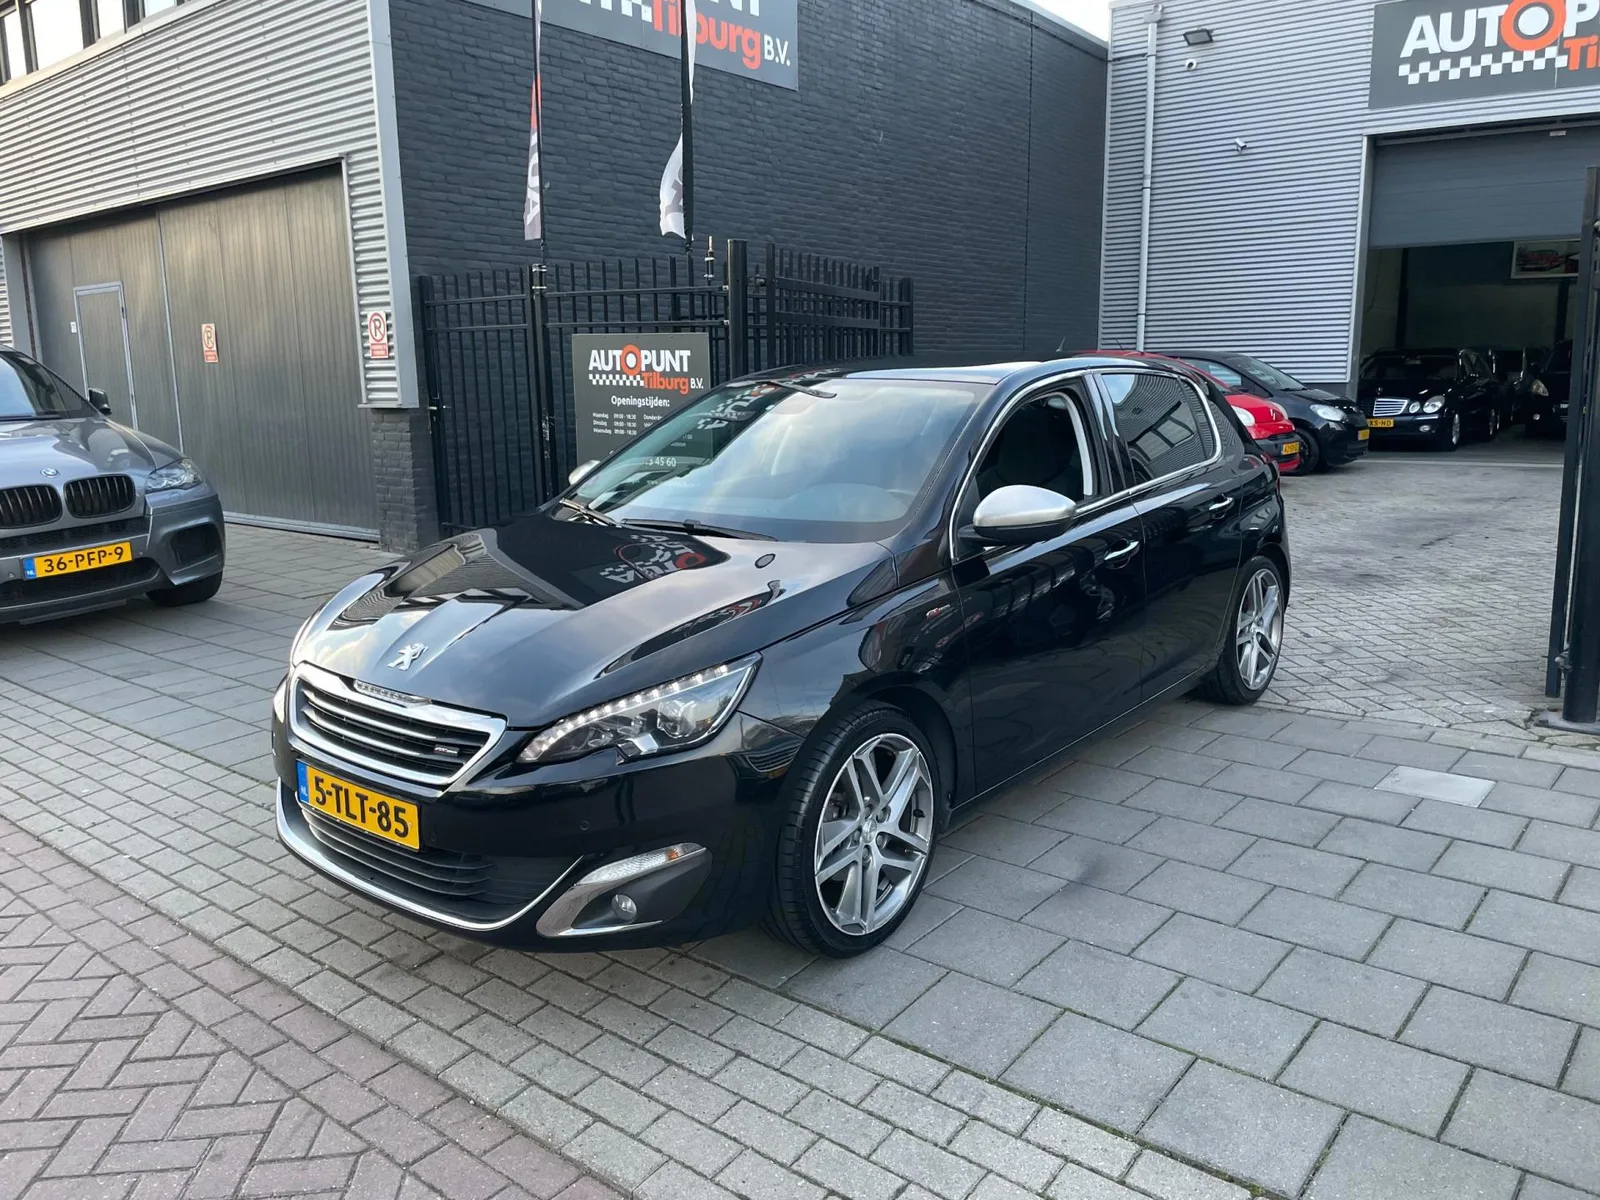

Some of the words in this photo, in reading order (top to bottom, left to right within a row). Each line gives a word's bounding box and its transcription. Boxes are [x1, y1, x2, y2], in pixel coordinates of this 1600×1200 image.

[764, 34, 791, 67] B.V.
[1563, 34, 1600, 71] Ti
[589, 344, 691, 376] AUTOPUNT
[641, 371, 689, 395] Tilburg
[690, 377, 704, 389] B.V.
[611, 394, 670, 408] Openingstijden:
[666, 457, 677, 468] 60
[43, 546, 124, 573] 36-PFP-9
[314, 775, 410, 839] 5-TLT-85
